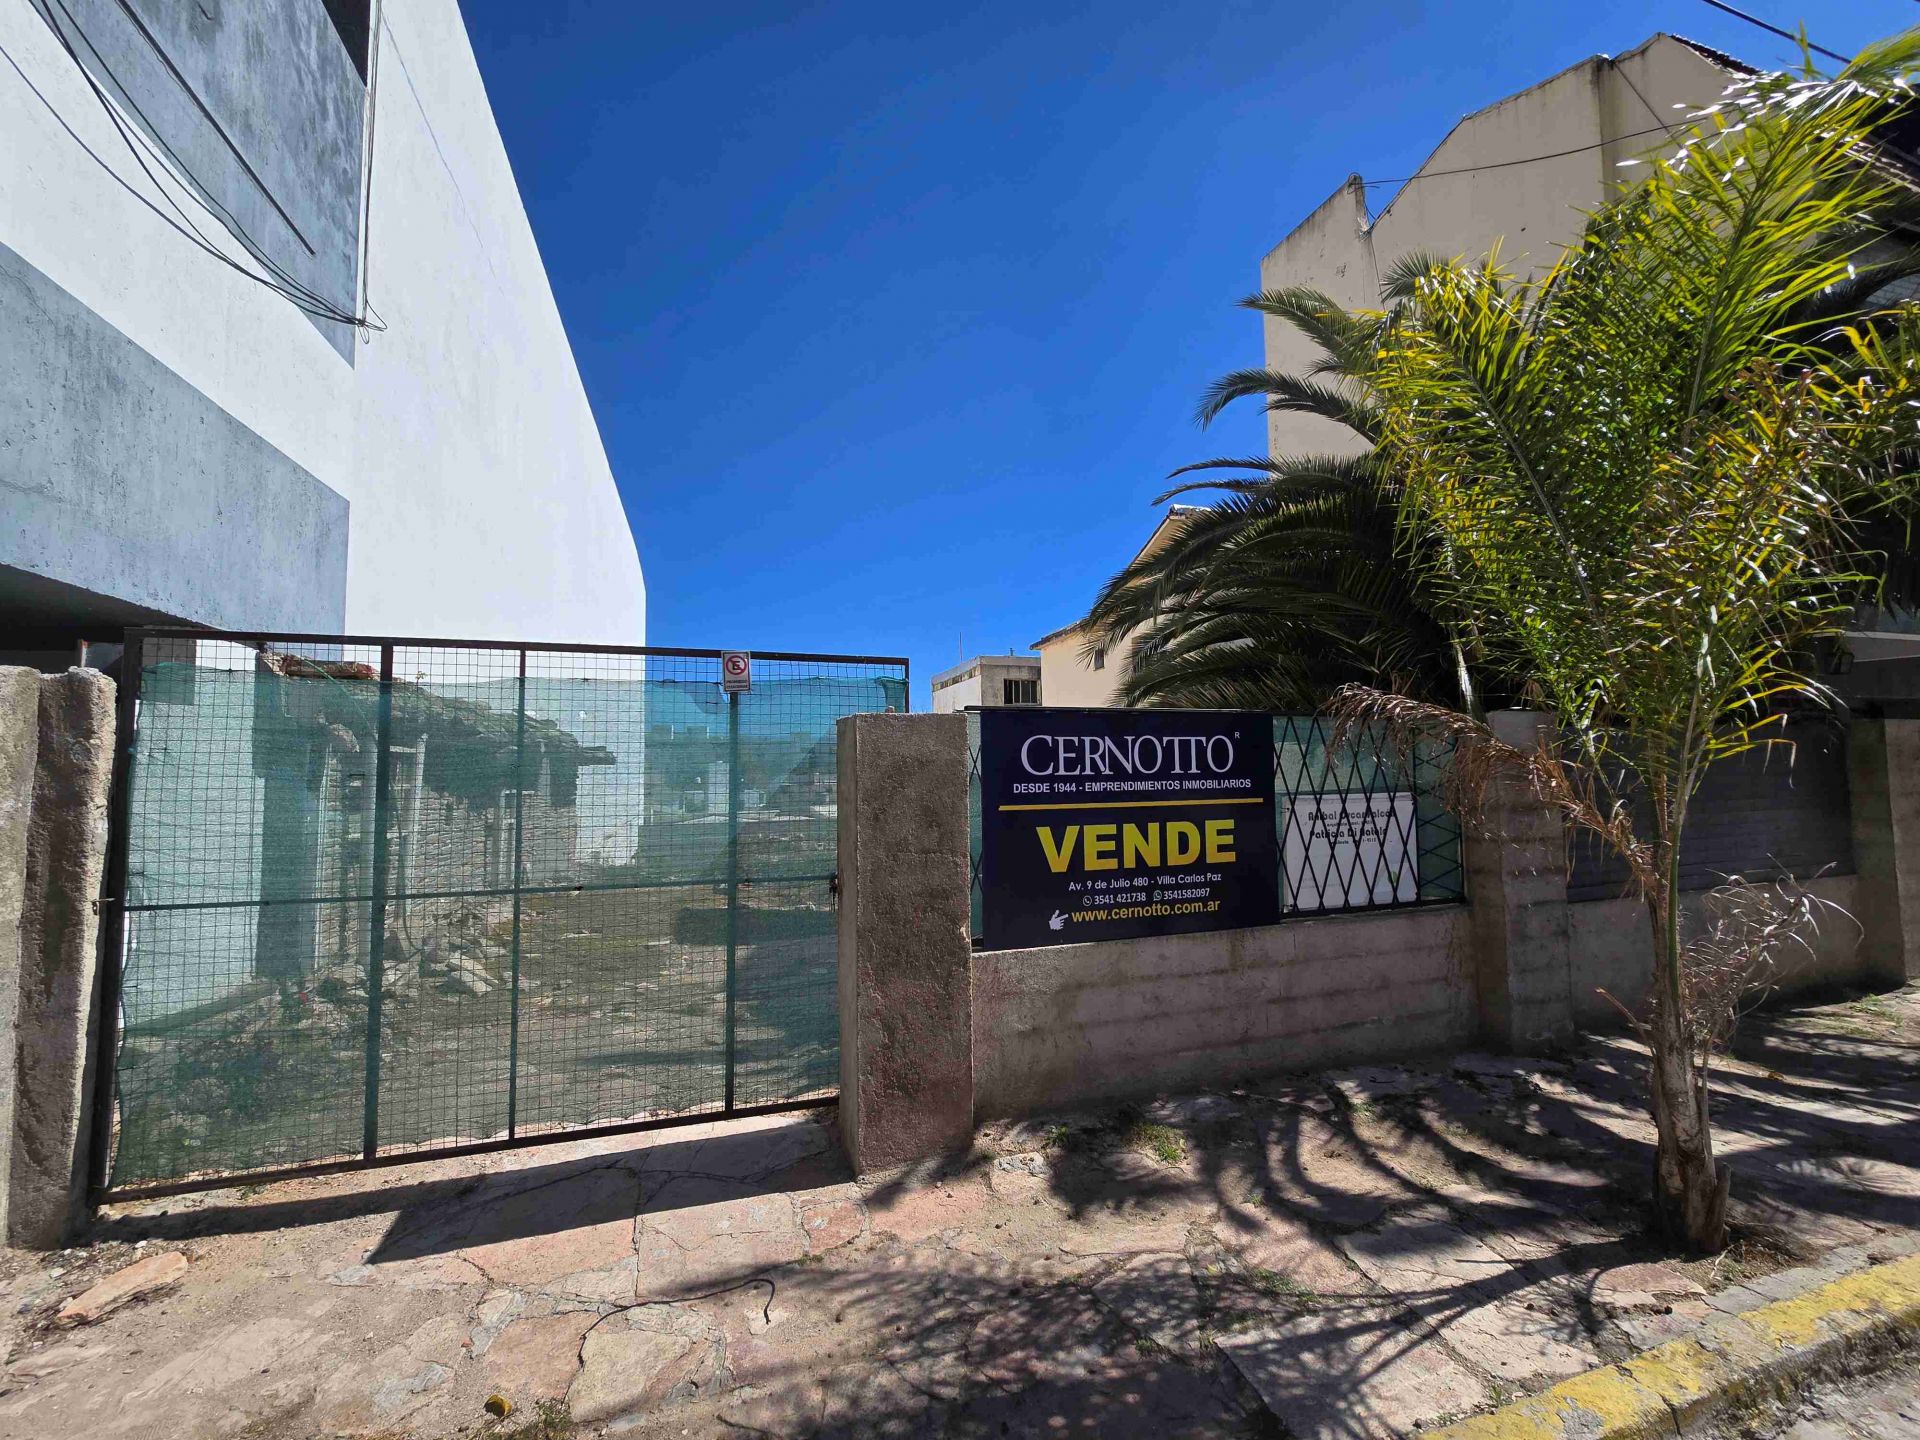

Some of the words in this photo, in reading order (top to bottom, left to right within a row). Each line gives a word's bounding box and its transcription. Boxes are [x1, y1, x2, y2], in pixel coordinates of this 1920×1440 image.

[1020, 734, 1234, 776] CERNOTTO
[1013, 782, 1050, 794] DESDE
[1053, 782, 1077, 793] 1944
[1085, 780, 1180, 792] EMPRENDIMIENTOS
[1182, 778, 1251, 790] INMOBILIARIOS
[1036, 819, 1236, 873] VENDE
[1068, 881, 1084, 891] Av.
[1086, 880, 1092, 890] 9
[1094, 879, 1108, 889] de
[1109, 878, 1131, 888] Julio
[1132, 876, 1149, 887] 480
[1156, 875, 1176, 885] Villa
[1177, 873, 1205, 884] Carlos
[1206, 872, 1222, 882] Paz
[1094, 894, 1114, 905] 3541
[1116, 892, 1147, 903] 421738
[1163, 888, 1210, 900] 3541582097
[1071, 899, 1221, 922] www.cernotto.com.ar
